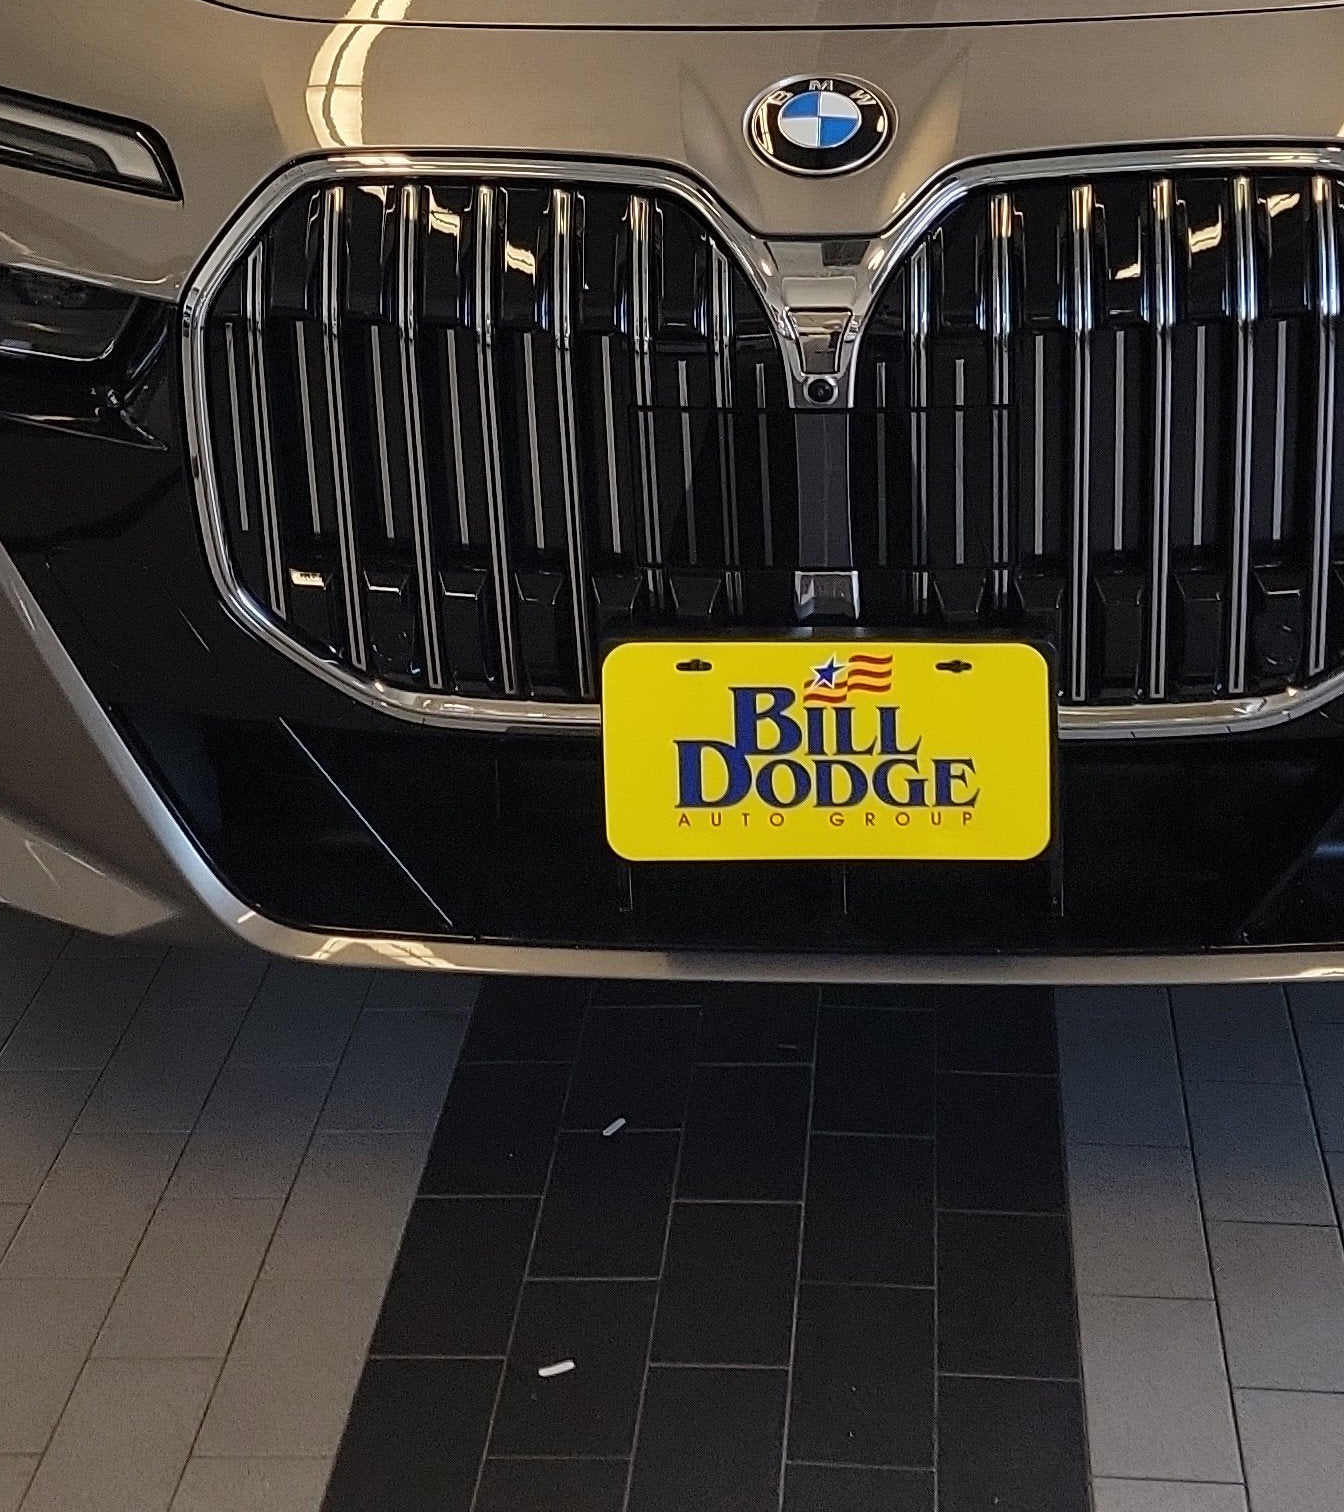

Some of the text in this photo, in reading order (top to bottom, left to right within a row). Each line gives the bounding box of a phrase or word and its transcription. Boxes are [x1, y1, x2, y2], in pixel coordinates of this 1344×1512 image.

[766, 79, 878, 106] BMW
[728, 686, 923, 757] BILL
[673, 739, 981, 809] DODGE
[678, 812, 973, 826] AUTO GROUP
